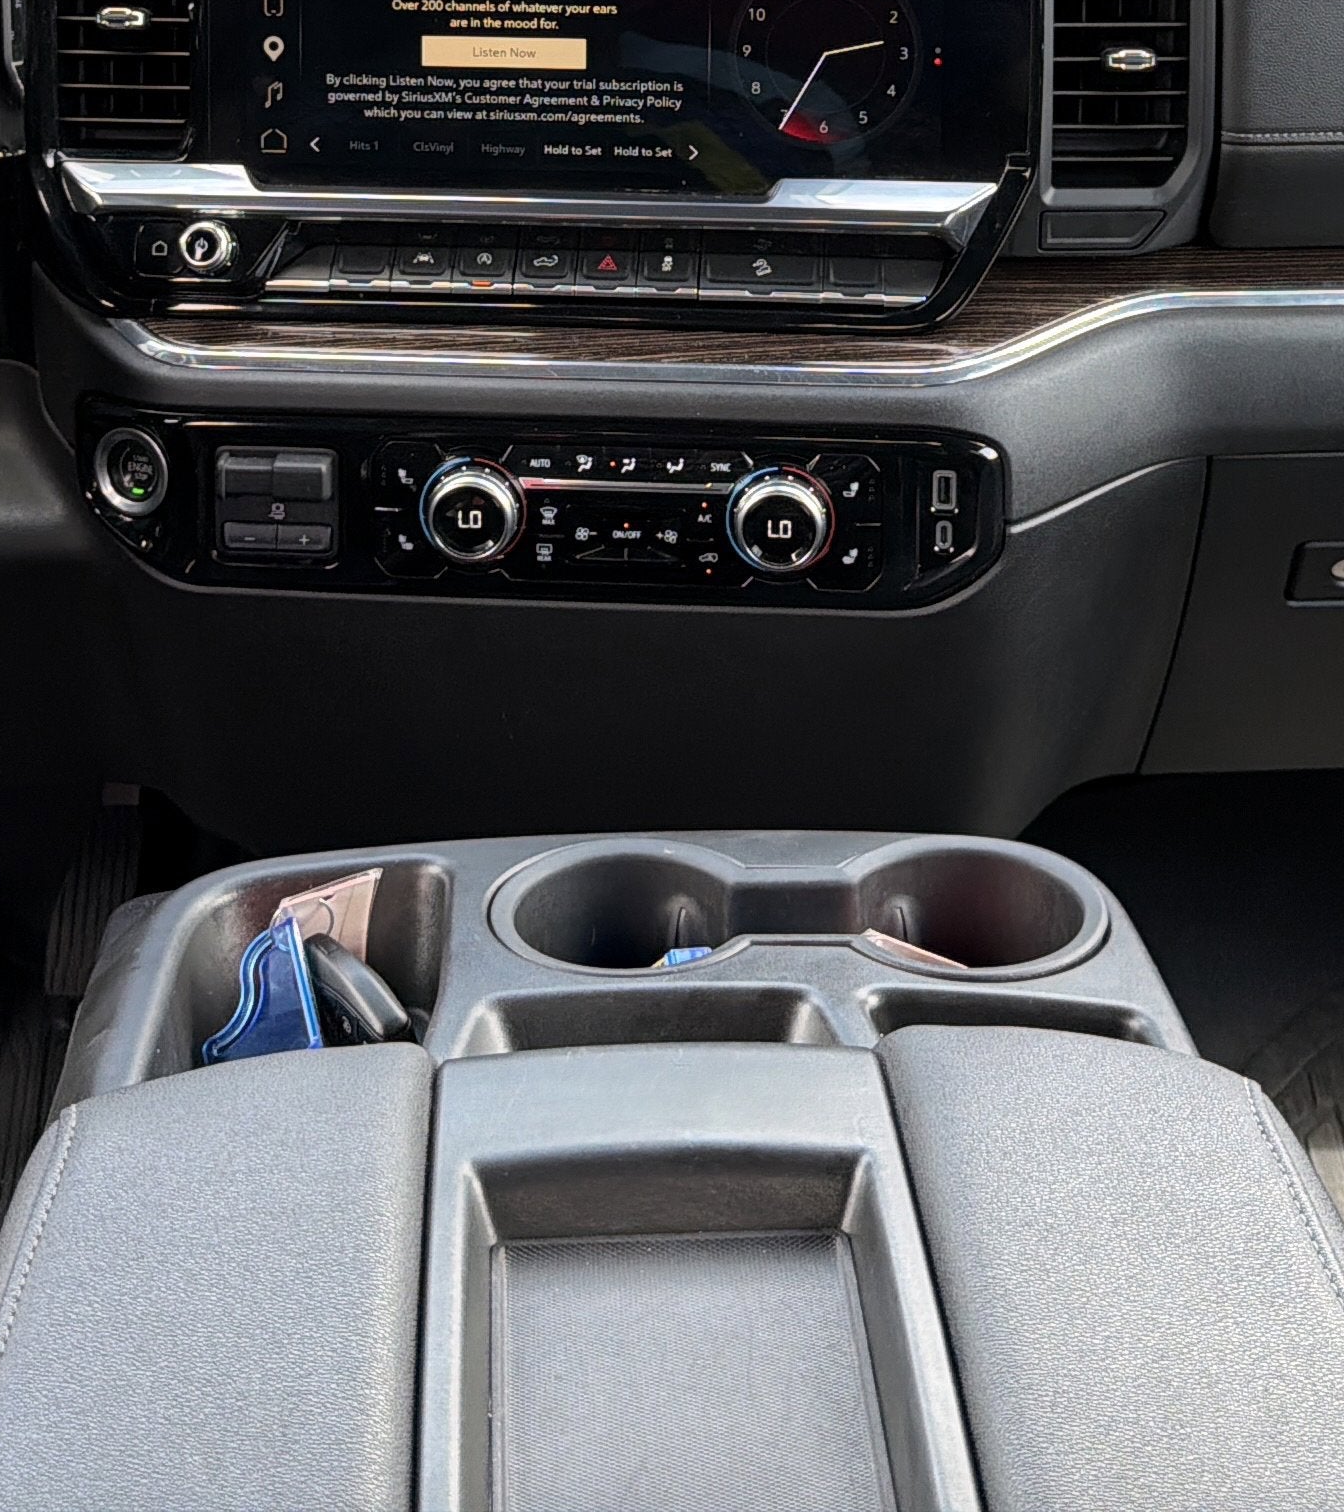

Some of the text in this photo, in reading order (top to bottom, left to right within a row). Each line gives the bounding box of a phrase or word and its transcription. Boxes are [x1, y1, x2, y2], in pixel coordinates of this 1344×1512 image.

[392, 0, 617, 17] Over 200 channels of whatever your ears
[748, 8, 766, 22] 10
[450, 17, 559, 30] are in the mood for.
[889, 10, 898, 24] 2
[472, 46, 537, 58] Listen Now
[742, 45, 752, 58] 9
[899, 47, 909, 60] 3
[326, 73, 683, 94] By clicking Listen Now, you agree that your trial subscription is
[751, 81, 761, 95] 8
[886, 84, 897, 97] 4
[328, 90, 682, 111] governed by SiriusXM's Customer Agreement & Privacy Policy
[364, 106, 644, 126] which you can view at siriusxm.com/agreements.
[859, 110, 868, 124] 5
[819, 120, 829, 134] 6
[349, 140, 379, 151] Hits 1
[481, 143, 525, 157] Highway
[544, 144, 602, 156] Hold to Set
[614, 146, 672, 158] Hold to Set
[529, 458, 551, 468] AUTO
[710, 462, 731, 473] SYNC
[697, 514, 712, 524] A/C
[612, 530, 641, 539] ON/OFF
